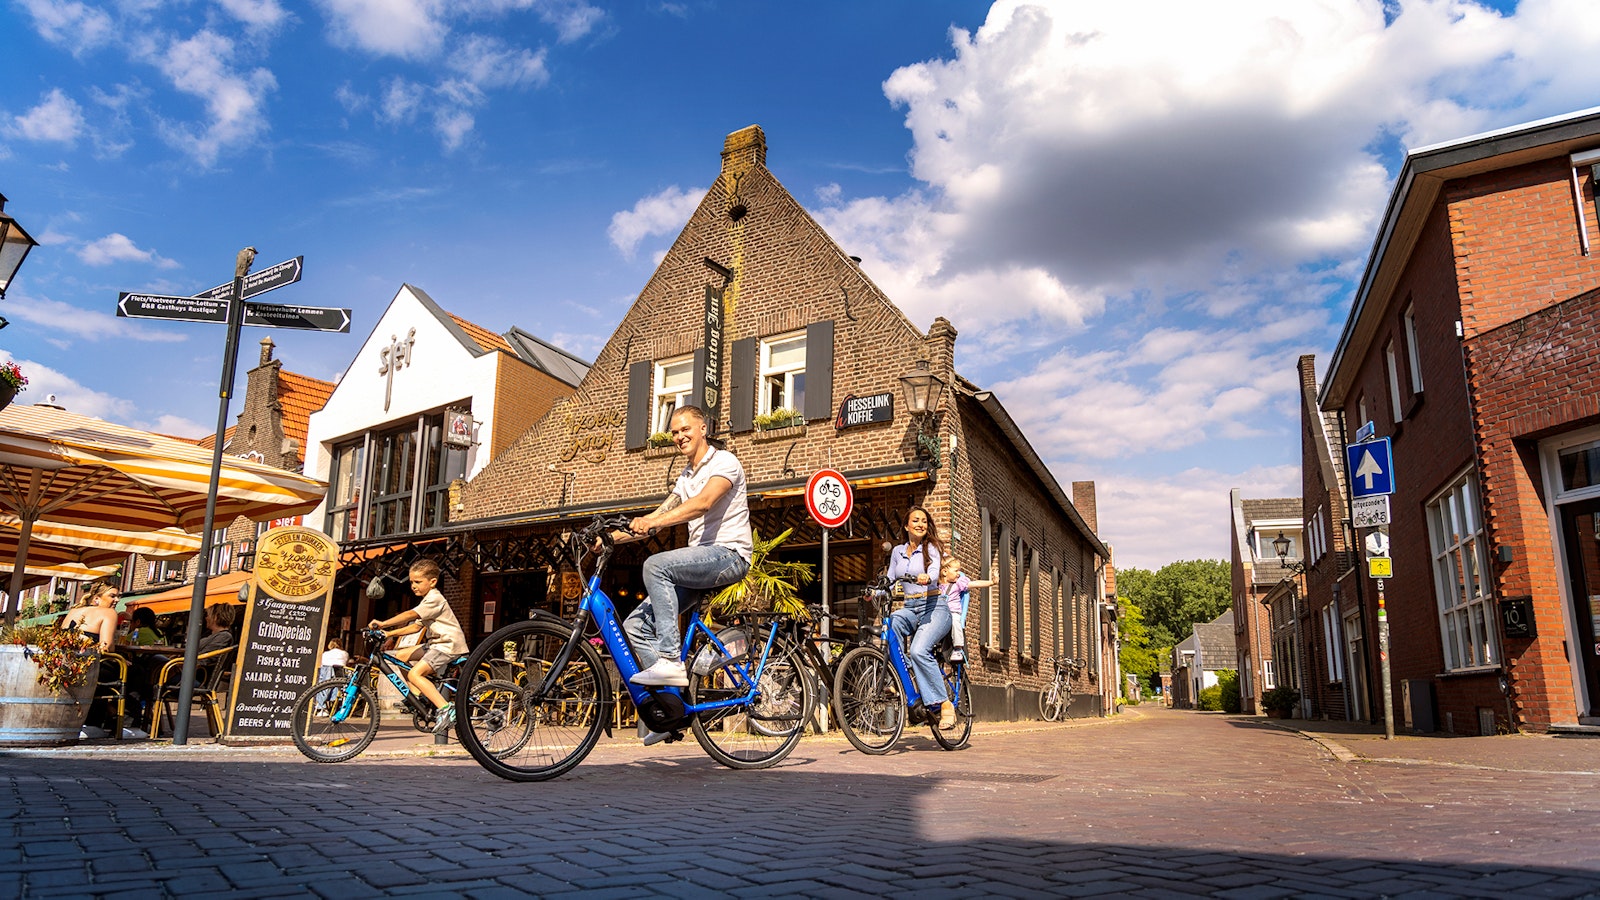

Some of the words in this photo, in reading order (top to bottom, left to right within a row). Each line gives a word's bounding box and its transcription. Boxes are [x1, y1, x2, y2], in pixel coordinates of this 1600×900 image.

[130, 295, 176, 304] Fiets/Voetveer
[176, 299, 218, 307] Arcen-Lottum
[156, 304, 186, 312] Gasthuys
[708, 297, 721, 330] Jan
[705, 328, 720, 386] Hertog
[848, 394, 890, 412] HESSELINK
[848, 410, 874, 424] KOFFIE
[1353, 498, 1386, 509] uitgezonderd
[281, 586, 306, 596] ARCEN
[1504, 609, 1520, 625] 10
[258, 621, 312, 641] Grillspecials
[251, 642, 284, 652] Burgers
[257, 655, 274, 666] FISH
[274, 658, 280, 666] &
[282, 657, 301, 668] SATÉ
[245, 672, 272, 682] SALADS
[275, 674, 281, 683] &
[284, 675, 307, 685] SOUPS
[252, 689, 278, 699] FINGER
[278, 690, 296, 700] FOOD
[236, 702, 274, 713] Breakfast
[238, 718, 264, 727] BEERS
[265, 719, 271, 728] &
